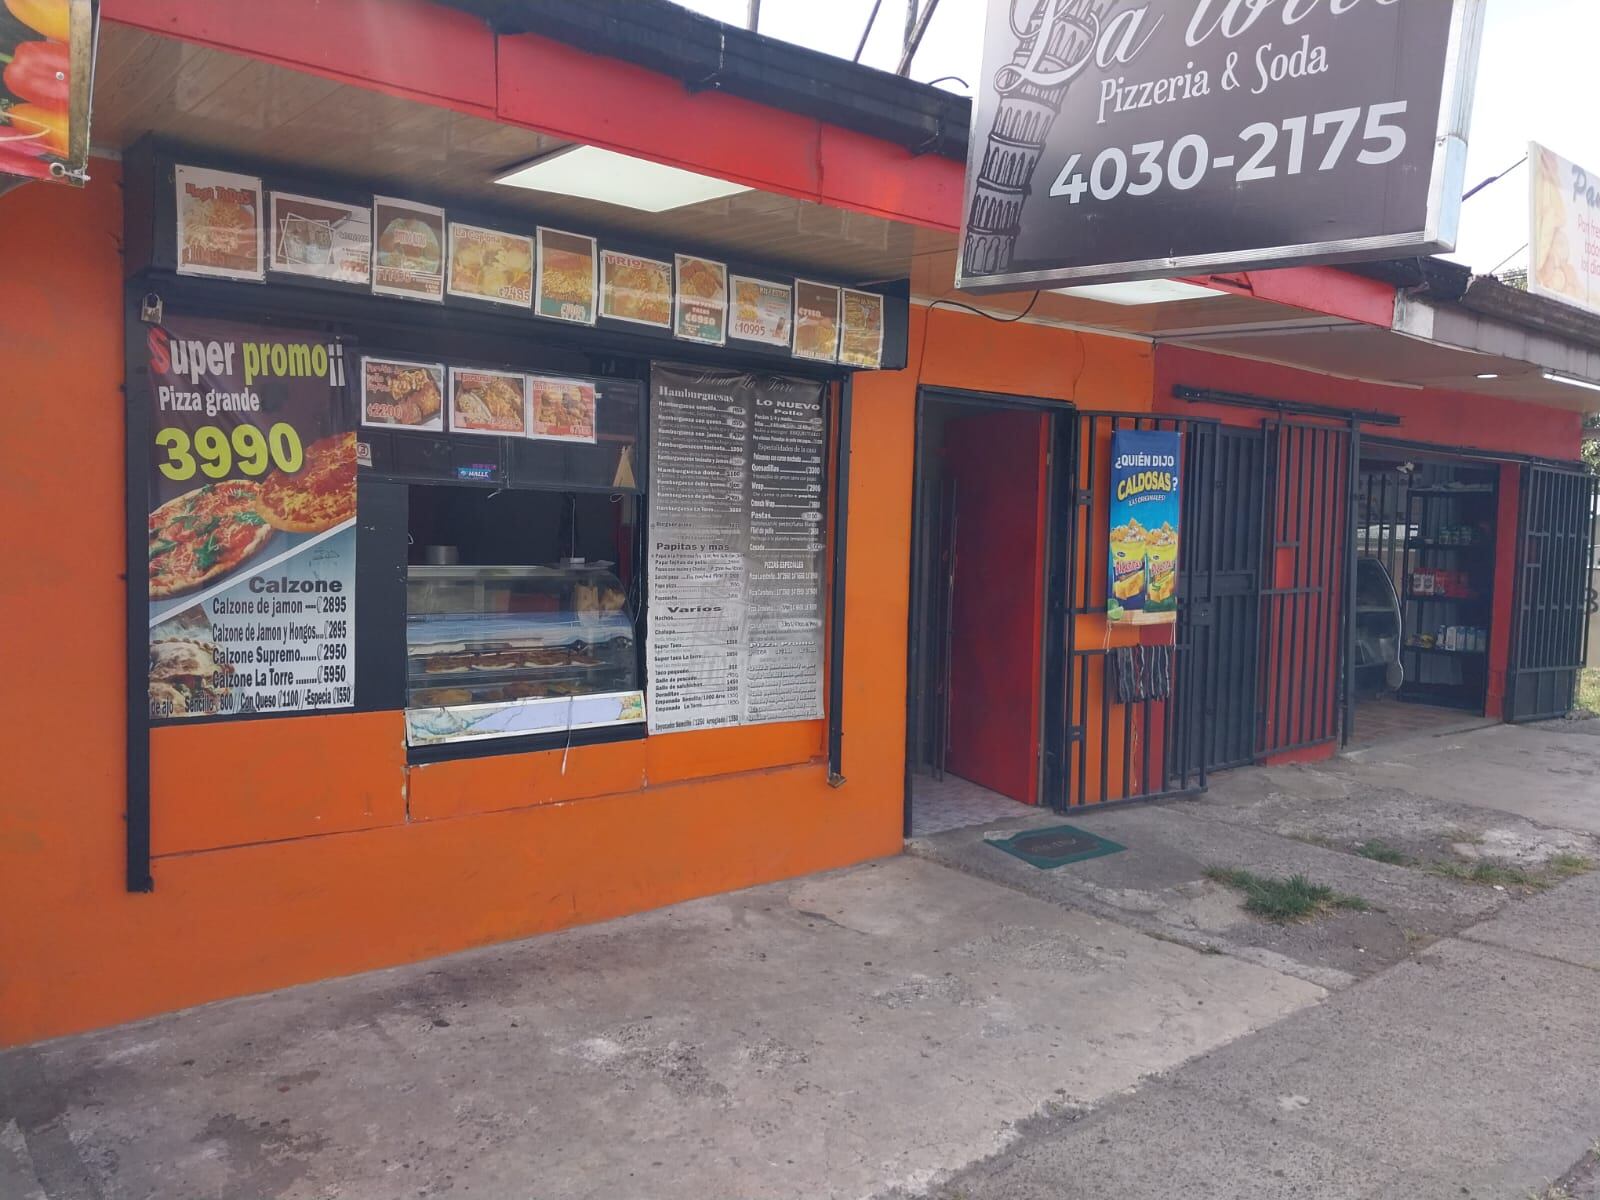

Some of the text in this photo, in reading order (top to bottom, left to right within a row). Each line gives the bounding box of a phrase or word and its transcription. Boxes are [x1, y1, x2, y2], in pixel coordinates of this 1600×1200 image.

[1097, 34, 1328, 124] Pizzeria & Soda
[1049, 100, 1408, 205] 4030-2175
[147, 327, 235, 384] Super
[159, 386, 260, 417] Pizza grande
[658, 385, 734, 402] Hamburguesas
[776, 400, 820, 411] NUEVO
[155, 422, 303, 481] 3990
[1115, 452, 1174, 469] ¿QUIÉN DIJO
[656, 542, 698, 551] Papitas
[250, 576, 343, 593] Calzone
[212, 597, 255, 615] Calzone
[257, 597, 270, 614] de
[271, 600, 303, 617] jamon
[667, 605, 722, 613] Varios
[212, 622, 244, 641] Calzone
[245, 623, 255, 641] de
[257, 623, 282, 641] Jamon
[283, 628, 287, 644] y
[212, 647, 254, 664] Calzone
[212, 670, 253, 688] Calzone
[255, 669, 267, 686] La
[269, 668, 293, 686] Torre
[255, 692, 276, 711] Queso
